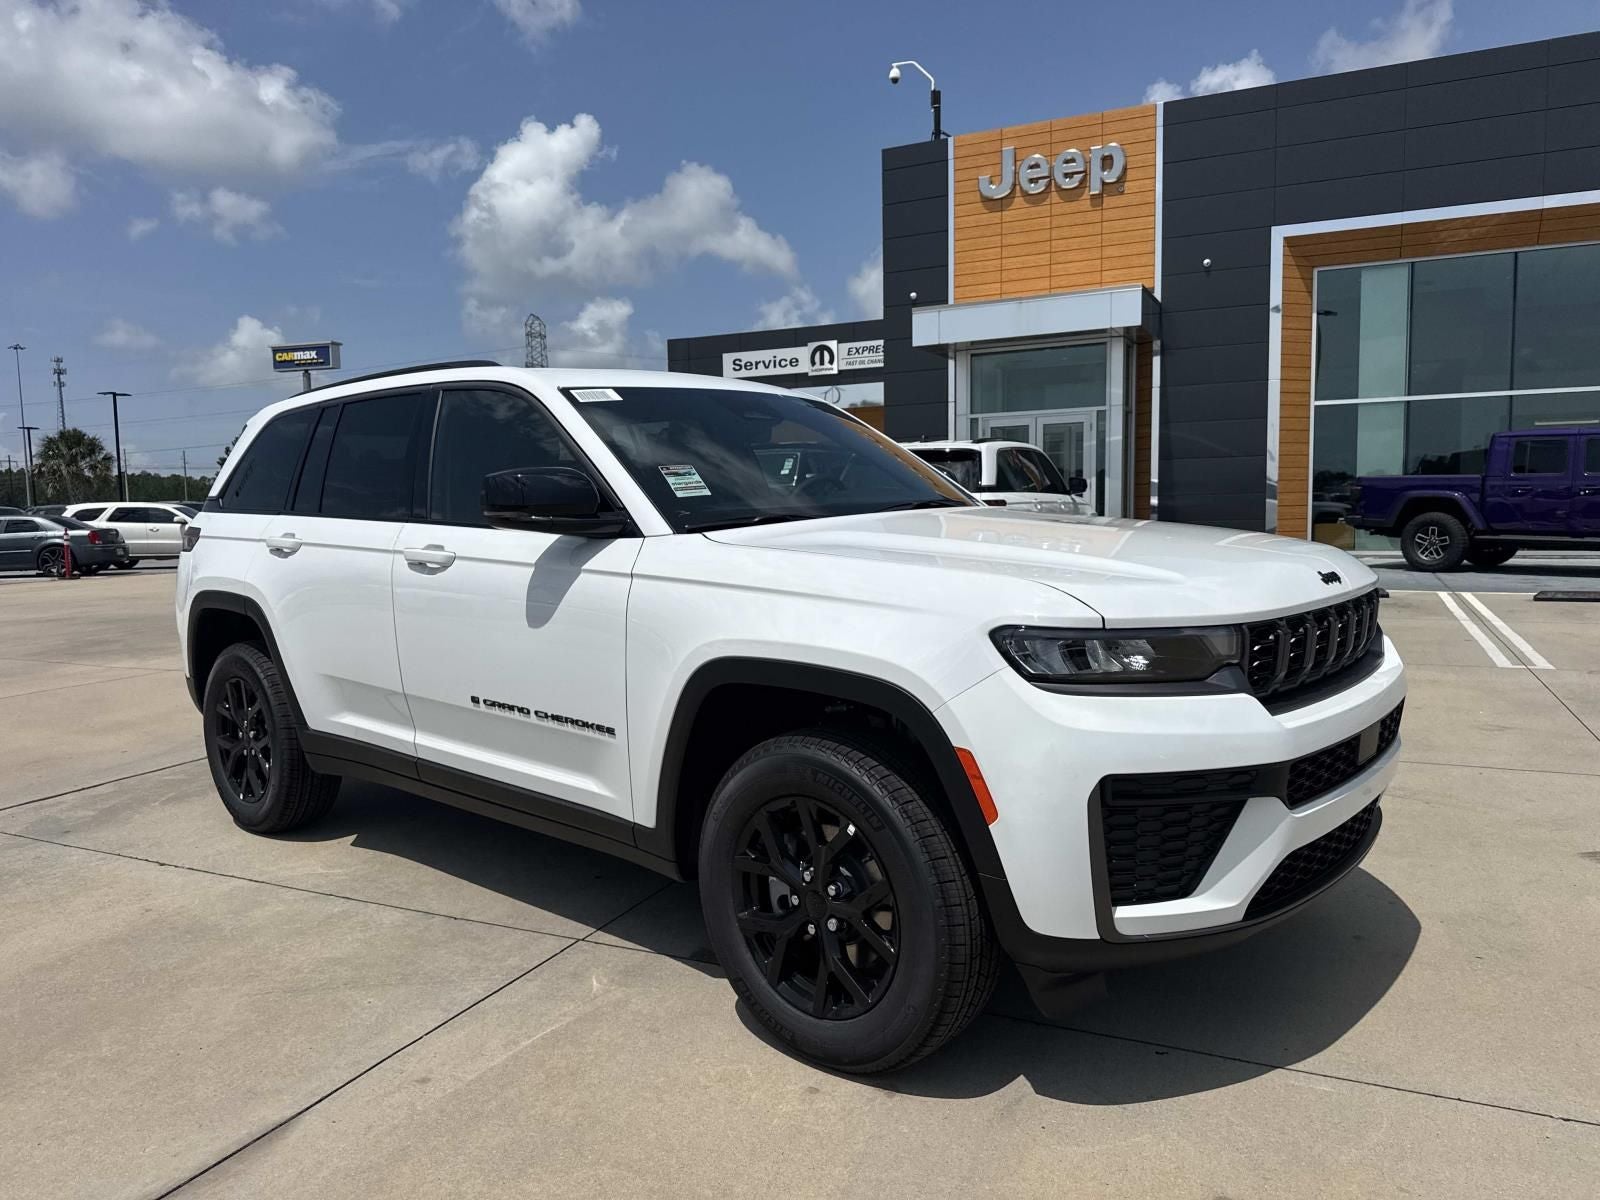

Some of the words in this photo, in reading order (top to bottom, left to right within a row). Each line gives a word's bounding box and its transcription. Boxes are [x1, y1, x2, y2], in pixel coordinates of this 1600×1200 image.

[978, 142, 1126, 199] Jeep
[732, 355, 799, 372] Service
[483, 699, 531, 715] GRAND
[534, 710, 616, 736] CHEROKEE
[813, 769, 886, 831] MICHELIN
